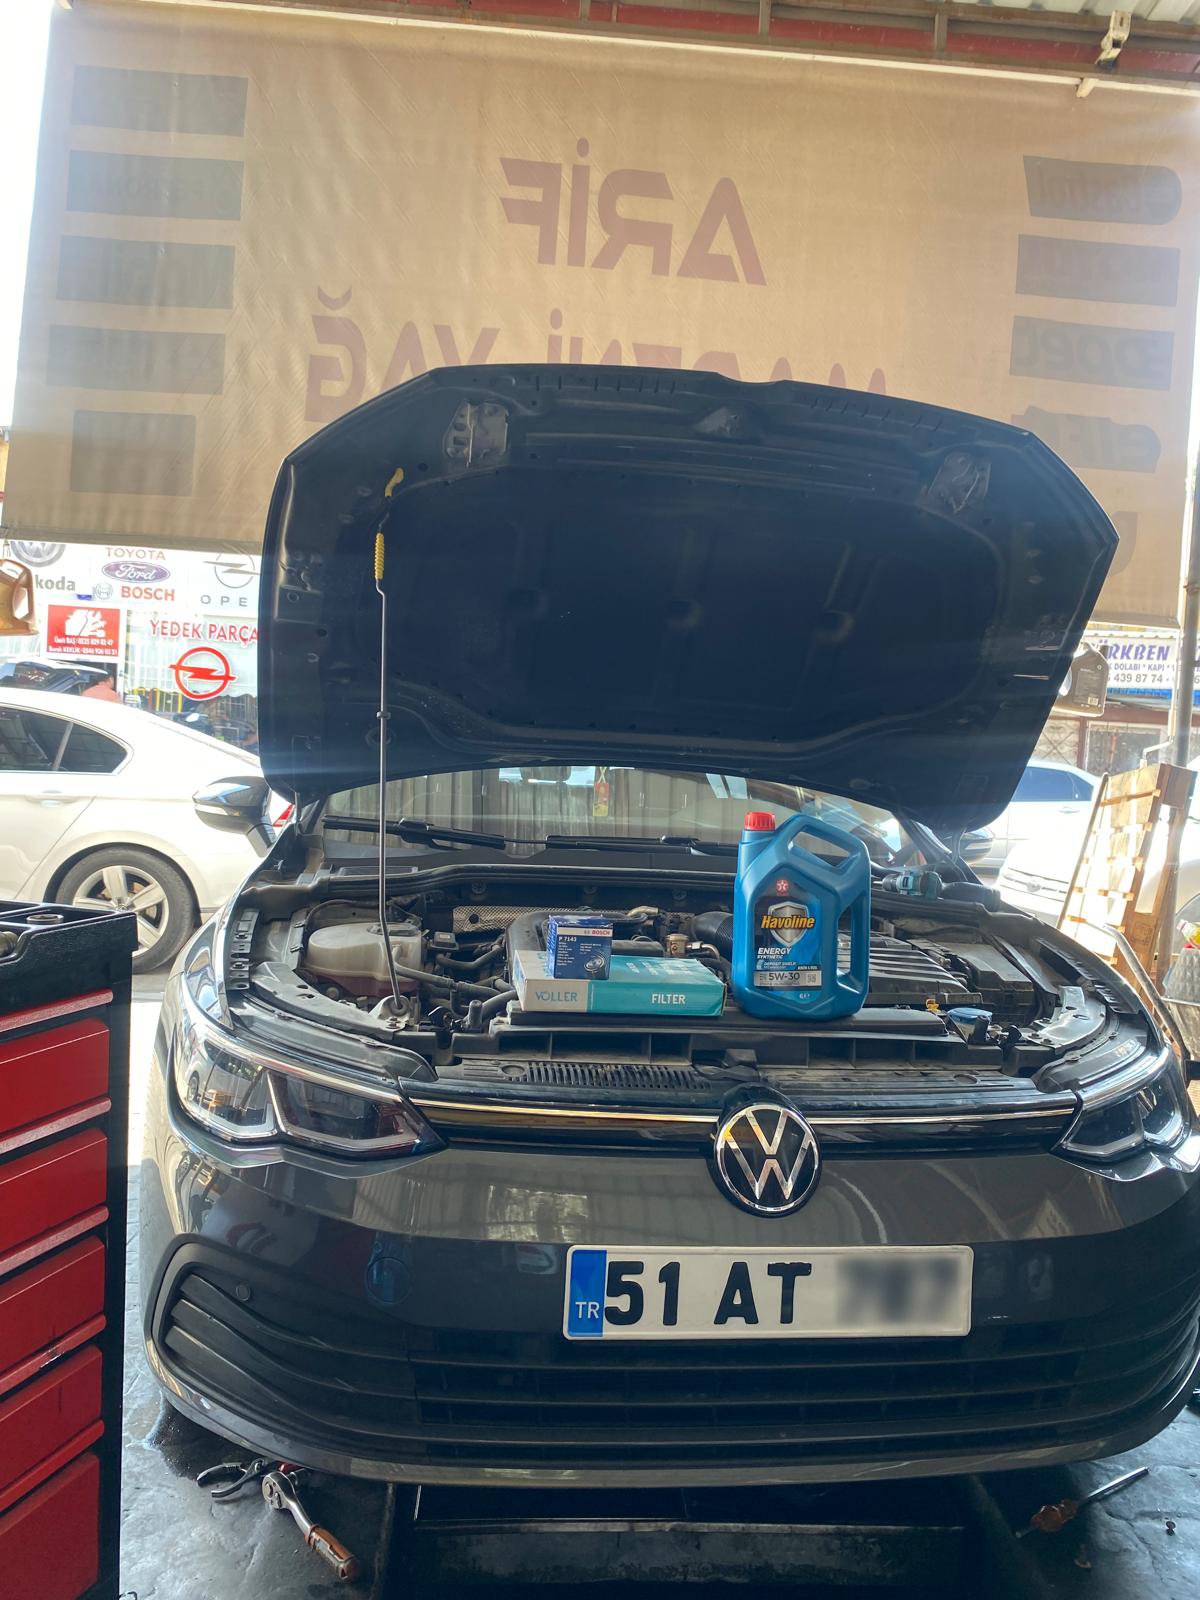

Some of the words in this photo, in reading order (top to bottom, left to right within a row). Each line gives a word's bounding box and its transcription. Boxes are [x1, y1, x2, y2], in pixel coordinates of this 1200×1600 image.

[105, 546, 166, 561] TOYOTA
[115, 561, 157, 581] Ford
[35, 575, 76, 592] koda
[120, 586, 176, 602] BOSCH
[200, 594, 248, 607] OPE
[149, 619, 202, 640] YEDEK
[1147, 663, 1165, 672] KAPI
[1114, 673, 1132, 683] 439
[1135, 674, 1148, 683] 87
[1151, 674, 1164, 683] 74
[761, 915, 815, 929] Havoline
[757, 947, 792, 955] ENERGY
[768, 972, 800, 981] 5W-30
[651, 993, 686, 1005] FILTER
[575, 1301, 600, 1320] TR
[604, 1260, 682, 1327] 51
[713, 1261, 813, 1326] AT
